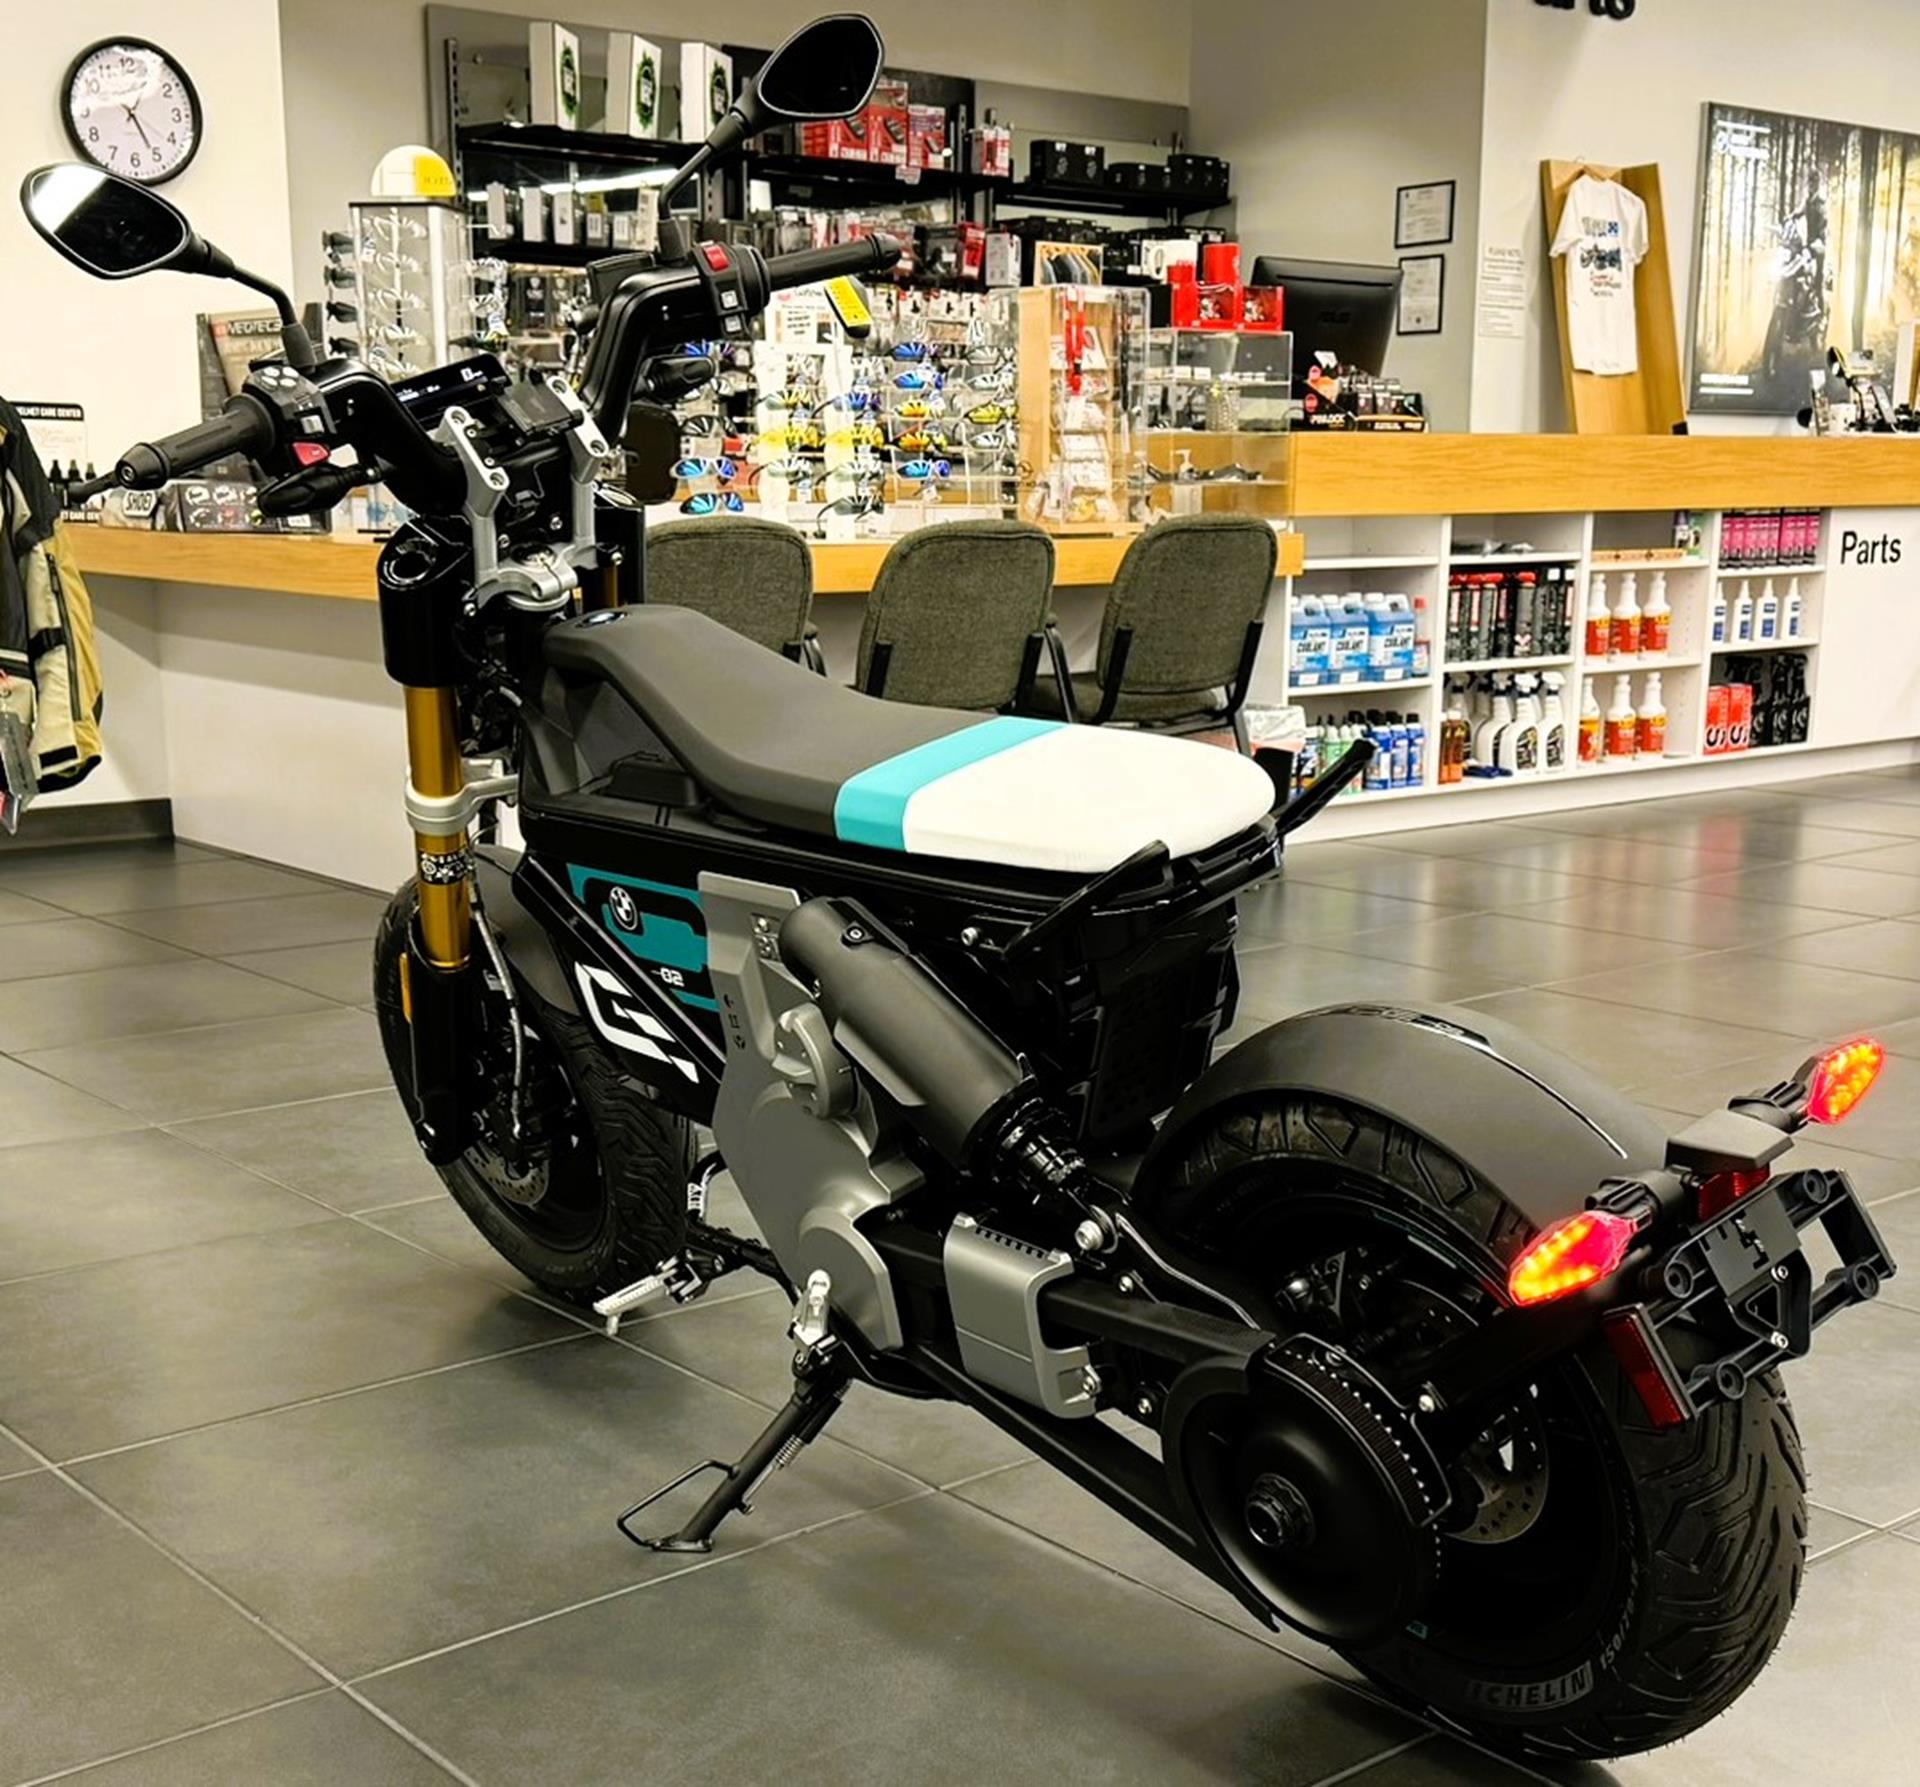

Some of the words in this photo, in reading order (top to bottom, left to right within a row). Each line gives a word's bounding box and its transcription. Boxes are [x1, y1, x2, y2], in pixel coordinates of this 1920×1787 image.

[120, 57, 135, 73] 12
[162, 82, 173, 99] 2
[171, 107, 182, 123] 3
[88, 126, 99, 142] 8
[167, 131, 177, 145] 4
[108, 145, 118, 160] 7
[130, 152, 141, 168] 6
[151, 147, 162, 162] 5
[41, 407, 56, 417] CARE
[57, 407, 81, 418] CENTER
[1840, 530, 1902, 565] Parts
[1467, 1664, 1590, 1707] ICHELIN
